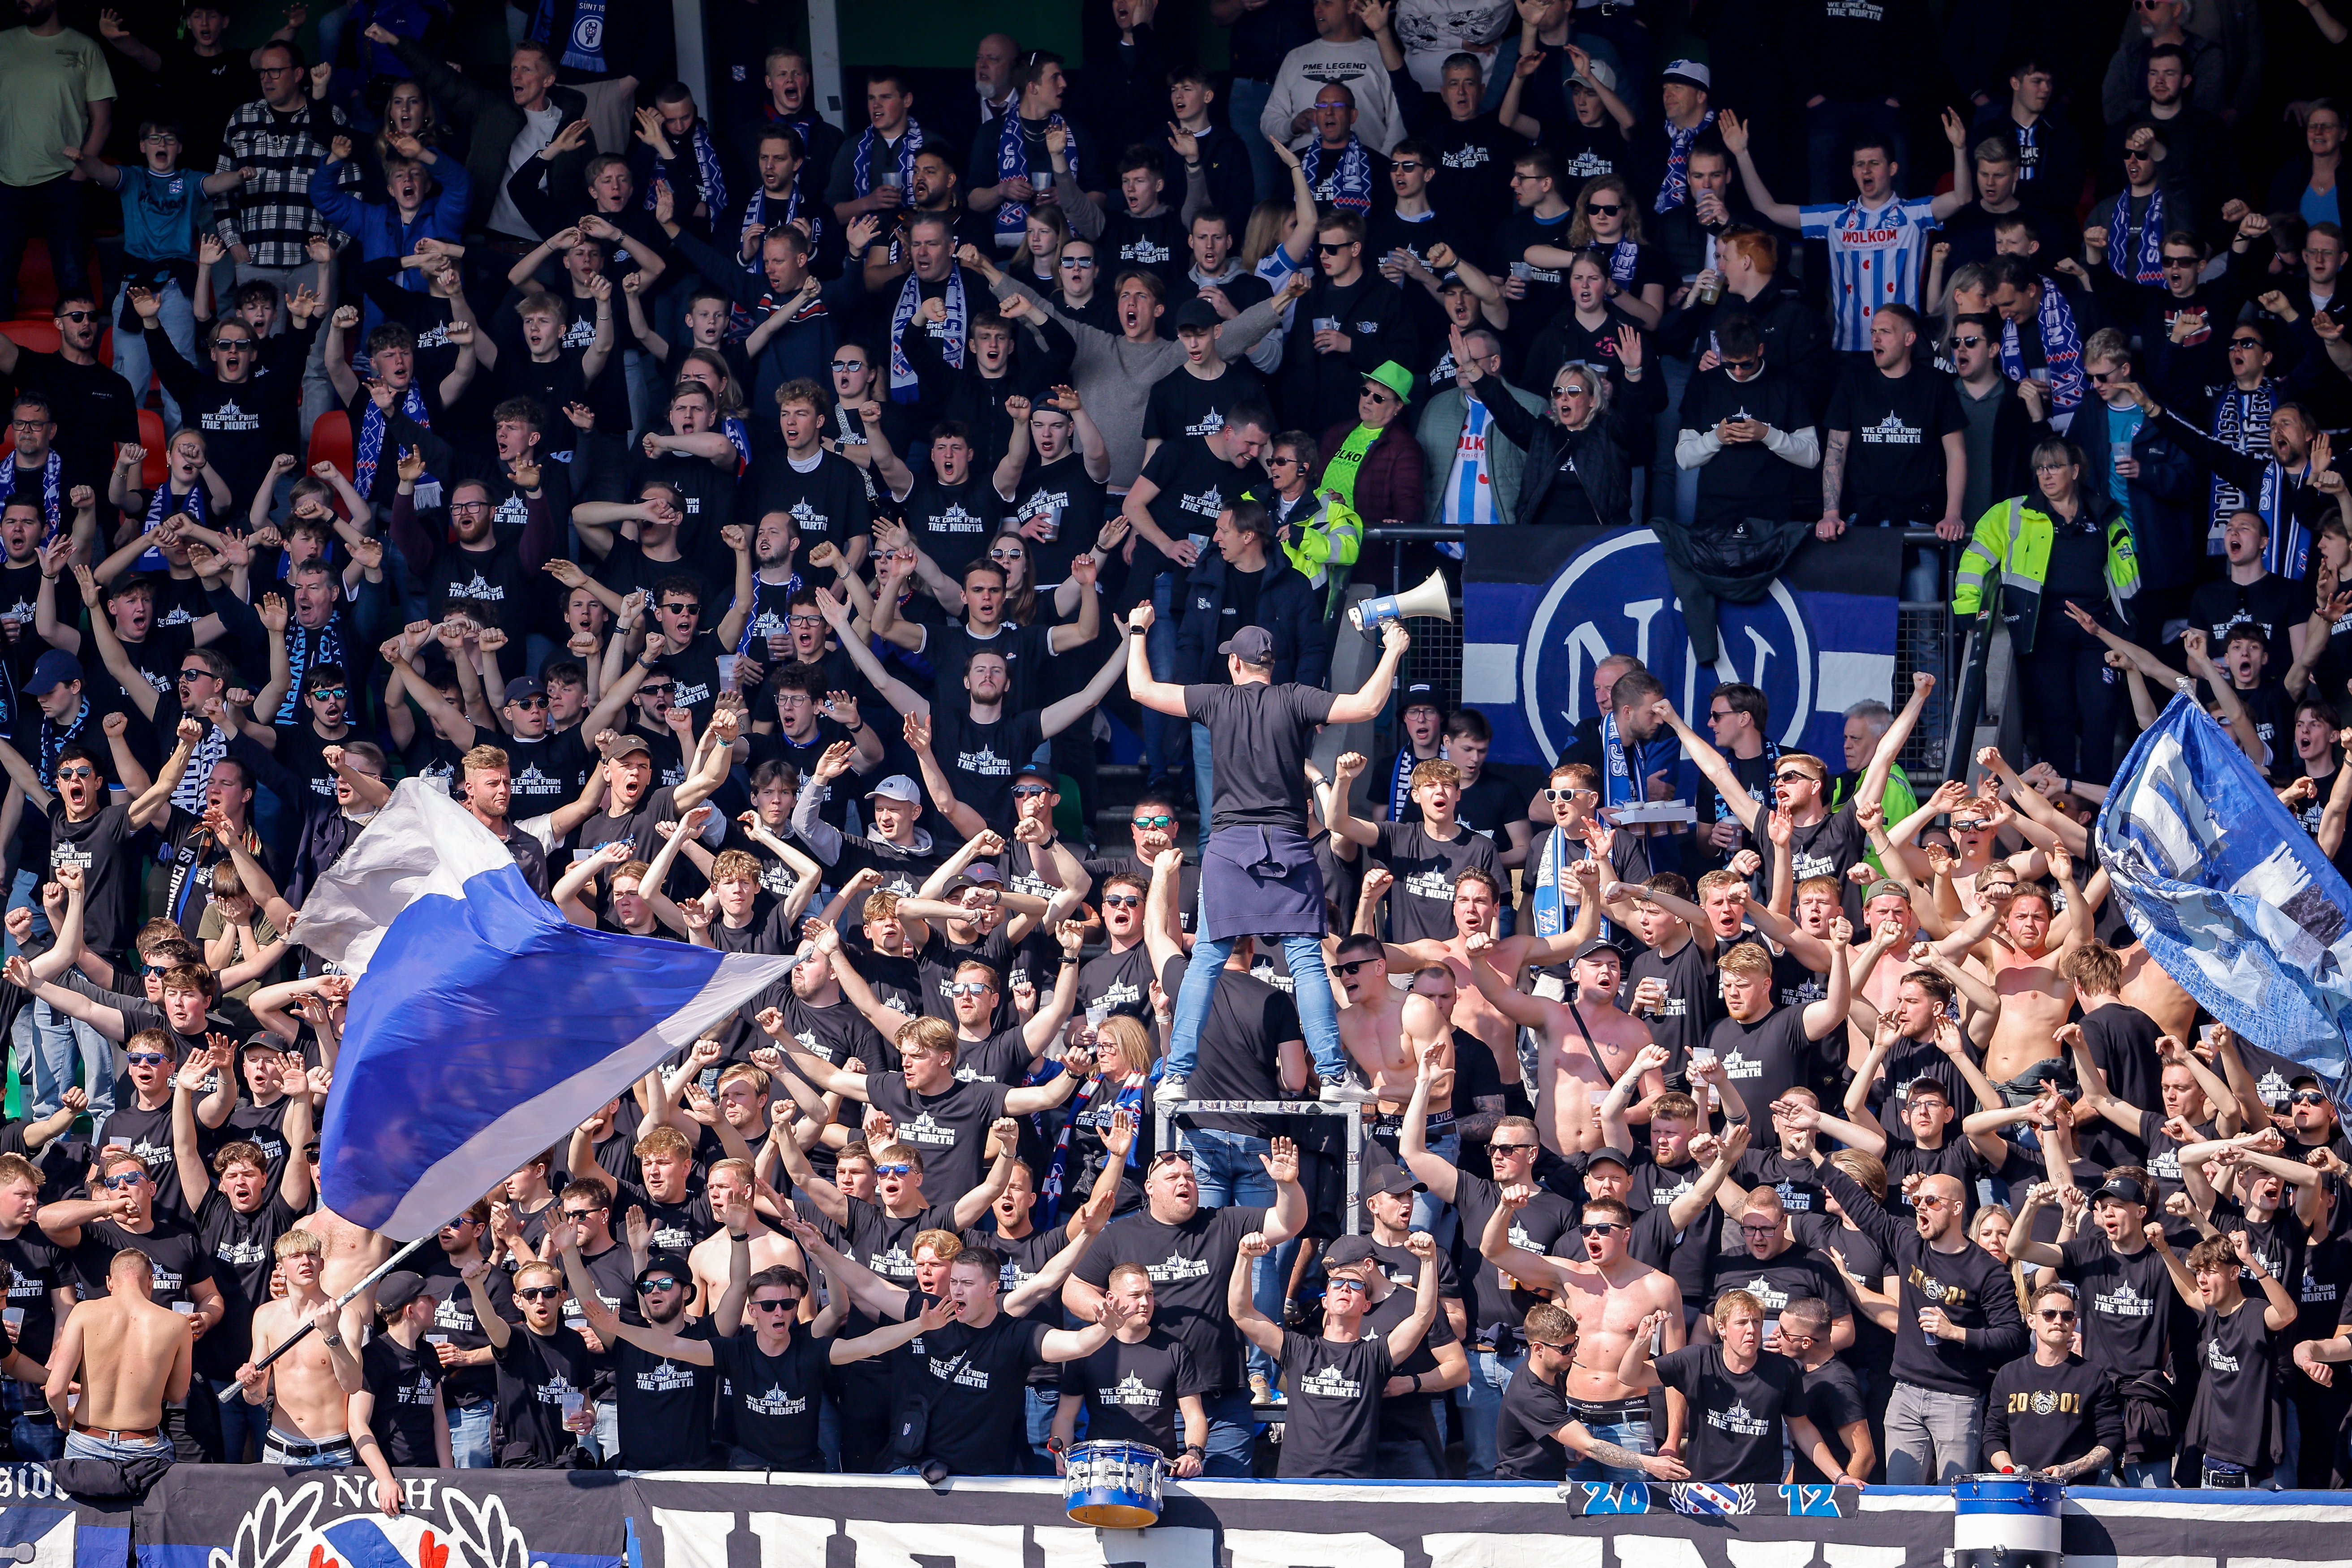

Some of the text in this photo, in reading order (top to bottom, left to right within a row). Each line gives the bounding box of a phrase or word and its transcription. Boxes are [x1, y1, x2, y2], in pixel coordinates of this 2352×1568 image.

[1864, 4, 1883, 12] FROM
[1827, 8, 1881, 21] THE NORTH
[1842, 229, 1897, 243] WOLKOM
[202, 420, 259, 430] THE NORTH
[1862, 434, 1921, 444] THE NORTH
[1017, 492, 1067, 515] WE COME FROM
[1180, 500, 1199, 512] THE
[1184, 494, 1215, 506] WE COME
[810, 514, 828, 522] FROM
[928, 523, 983, 532] THE NORTH
[686, 683, 706, 695] FROM
[674, 689, 709, 708] NORTH
[958, 760, 1010, 775] THE NORTH
[1810, 857, 1831, 866] FROM
[1799, 864, 1835, 879] NORTH
[1024, 878, 1045, 887] COME
[1407, 876, 1439, 888] WE COME
[1010, 883, 1030, 894] THE
[1406, 884, 1422, 894] THE
[1727, 1068, 1762, 1079] NORTH
[1075, 1118, 1095, 1127] THE
[934, 1127, 955, 1135] FROM
[1375, 1127, 1392, 1136] THE
[899, 1130, 954, 1146] THE NORTH
[261, 1142, 280, 1151] FROM
[1653, 1196, 1672, 1204] THE
[220, 1242, 229, 1250] WE
[659, 1239, 694, 1248] NORTH
[1524, 1240, 1546, 1251] FROM
[217, 1249, 265, 1264] THE NORTH
[872, 1253, 904, 1267] WE COME
[870, 1261, 887, 1273] THE
[1185, 1260, 1206, 1269] FROM
[1148, 1266, 1209, 1280] THE NORTH
[1908, 1264, 1923, 1288] 20
[8, 1287, 43, 1297] NORTH
[1945, 1286, 1966, 1305] 01
[2095, 1303, 2153, 1315] THE NORTH
[452, 1313, 473, 1321] FROM
[439, 1318, 472, 1331] NORTH
[930, 1357, 988, 1379] WE FROM
[930, 1364, 948, 1378] THE
[637, 1378, 694, 1391] THE NORTH
[1301, 1382, 1360, 1398] THE NORTH
[746, 1394, 759, 1403] WE
[785, 1396, 806, 1405] FROM
[1100, 1396, 1159, 1406] THE NORTH
[2008, 1392, 2080, 1413] 20 01
[746, 1400, 806, 1415] THE NORTH
[1708, 1409, 1722, 1417] WE
[1723, 1416, 1745, 1425] COME
[1708, 1416, 1768, 1435] THE NORTH
[1583, 1482, 1651, 1515] 20
